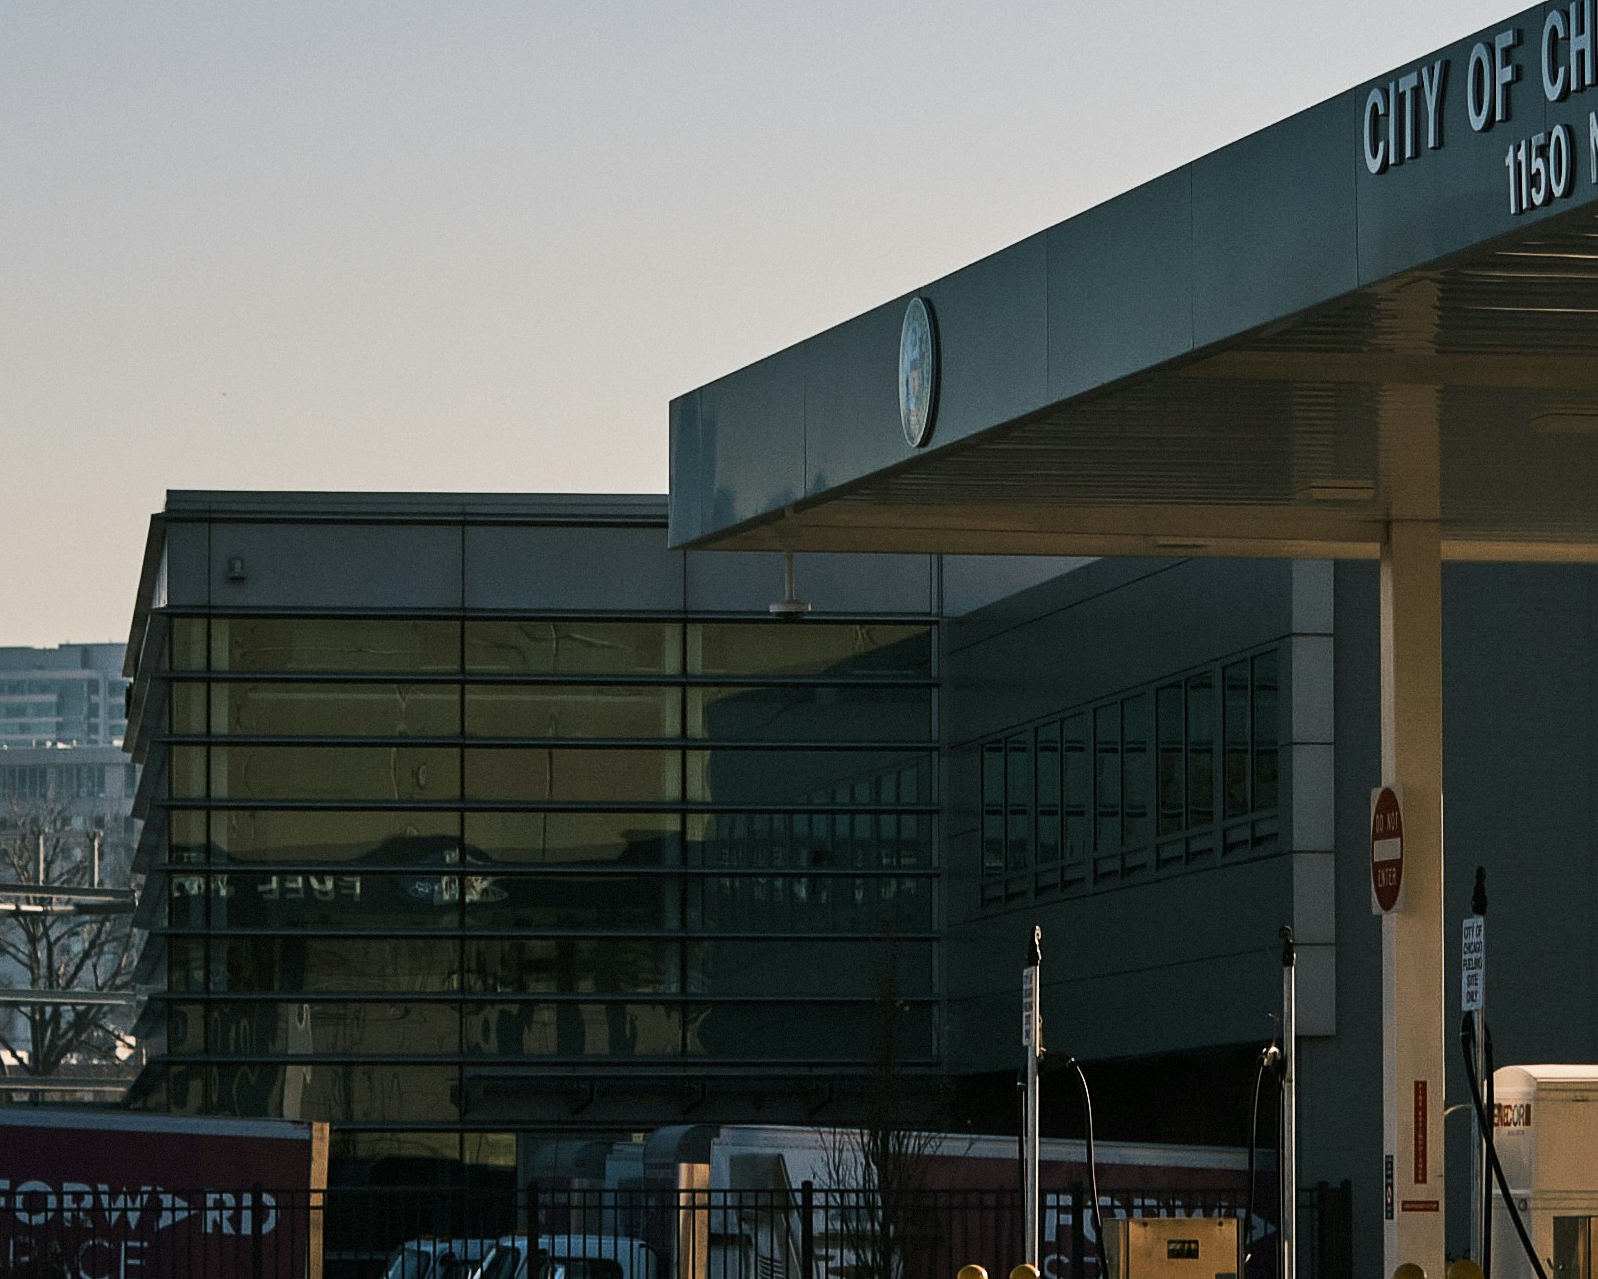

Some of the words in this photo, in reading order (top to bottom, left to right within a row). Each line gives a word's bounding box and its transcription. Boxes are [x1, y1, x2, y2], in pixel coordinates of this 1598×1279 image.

[1363, 59, 1450, 175] CITY
[1467, 28, 1522, 133] OF
[1504, 123, 1573, 215] 1150
